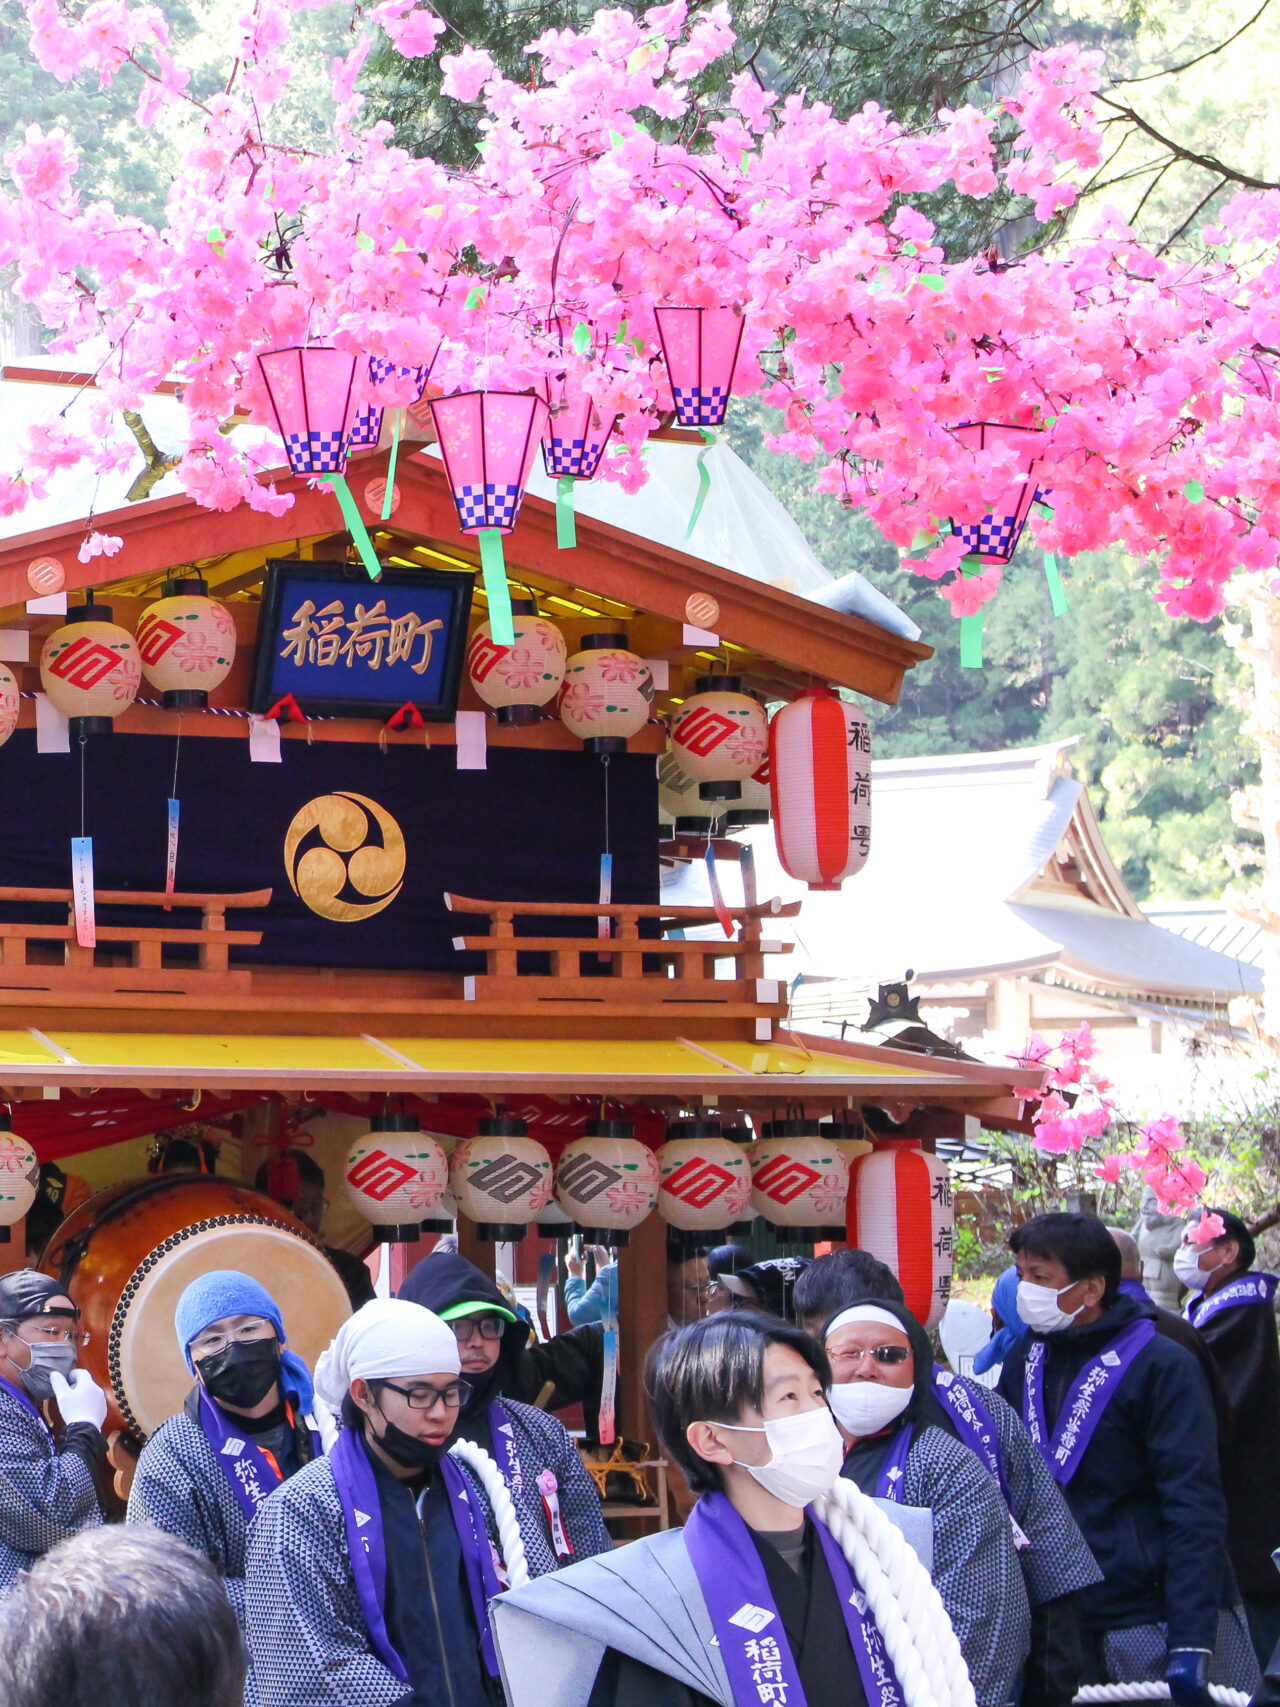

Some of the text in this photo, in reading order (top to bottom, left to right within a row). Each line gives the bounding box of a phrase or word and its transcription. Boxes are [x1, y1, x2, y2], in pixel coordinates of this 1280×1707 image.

[279, 599, 444, 676] 稲荷町
[1053, 1364, 1109, 1467] 弥生祭当番町
[743, 1635, 790, 1707] 稲荷町
